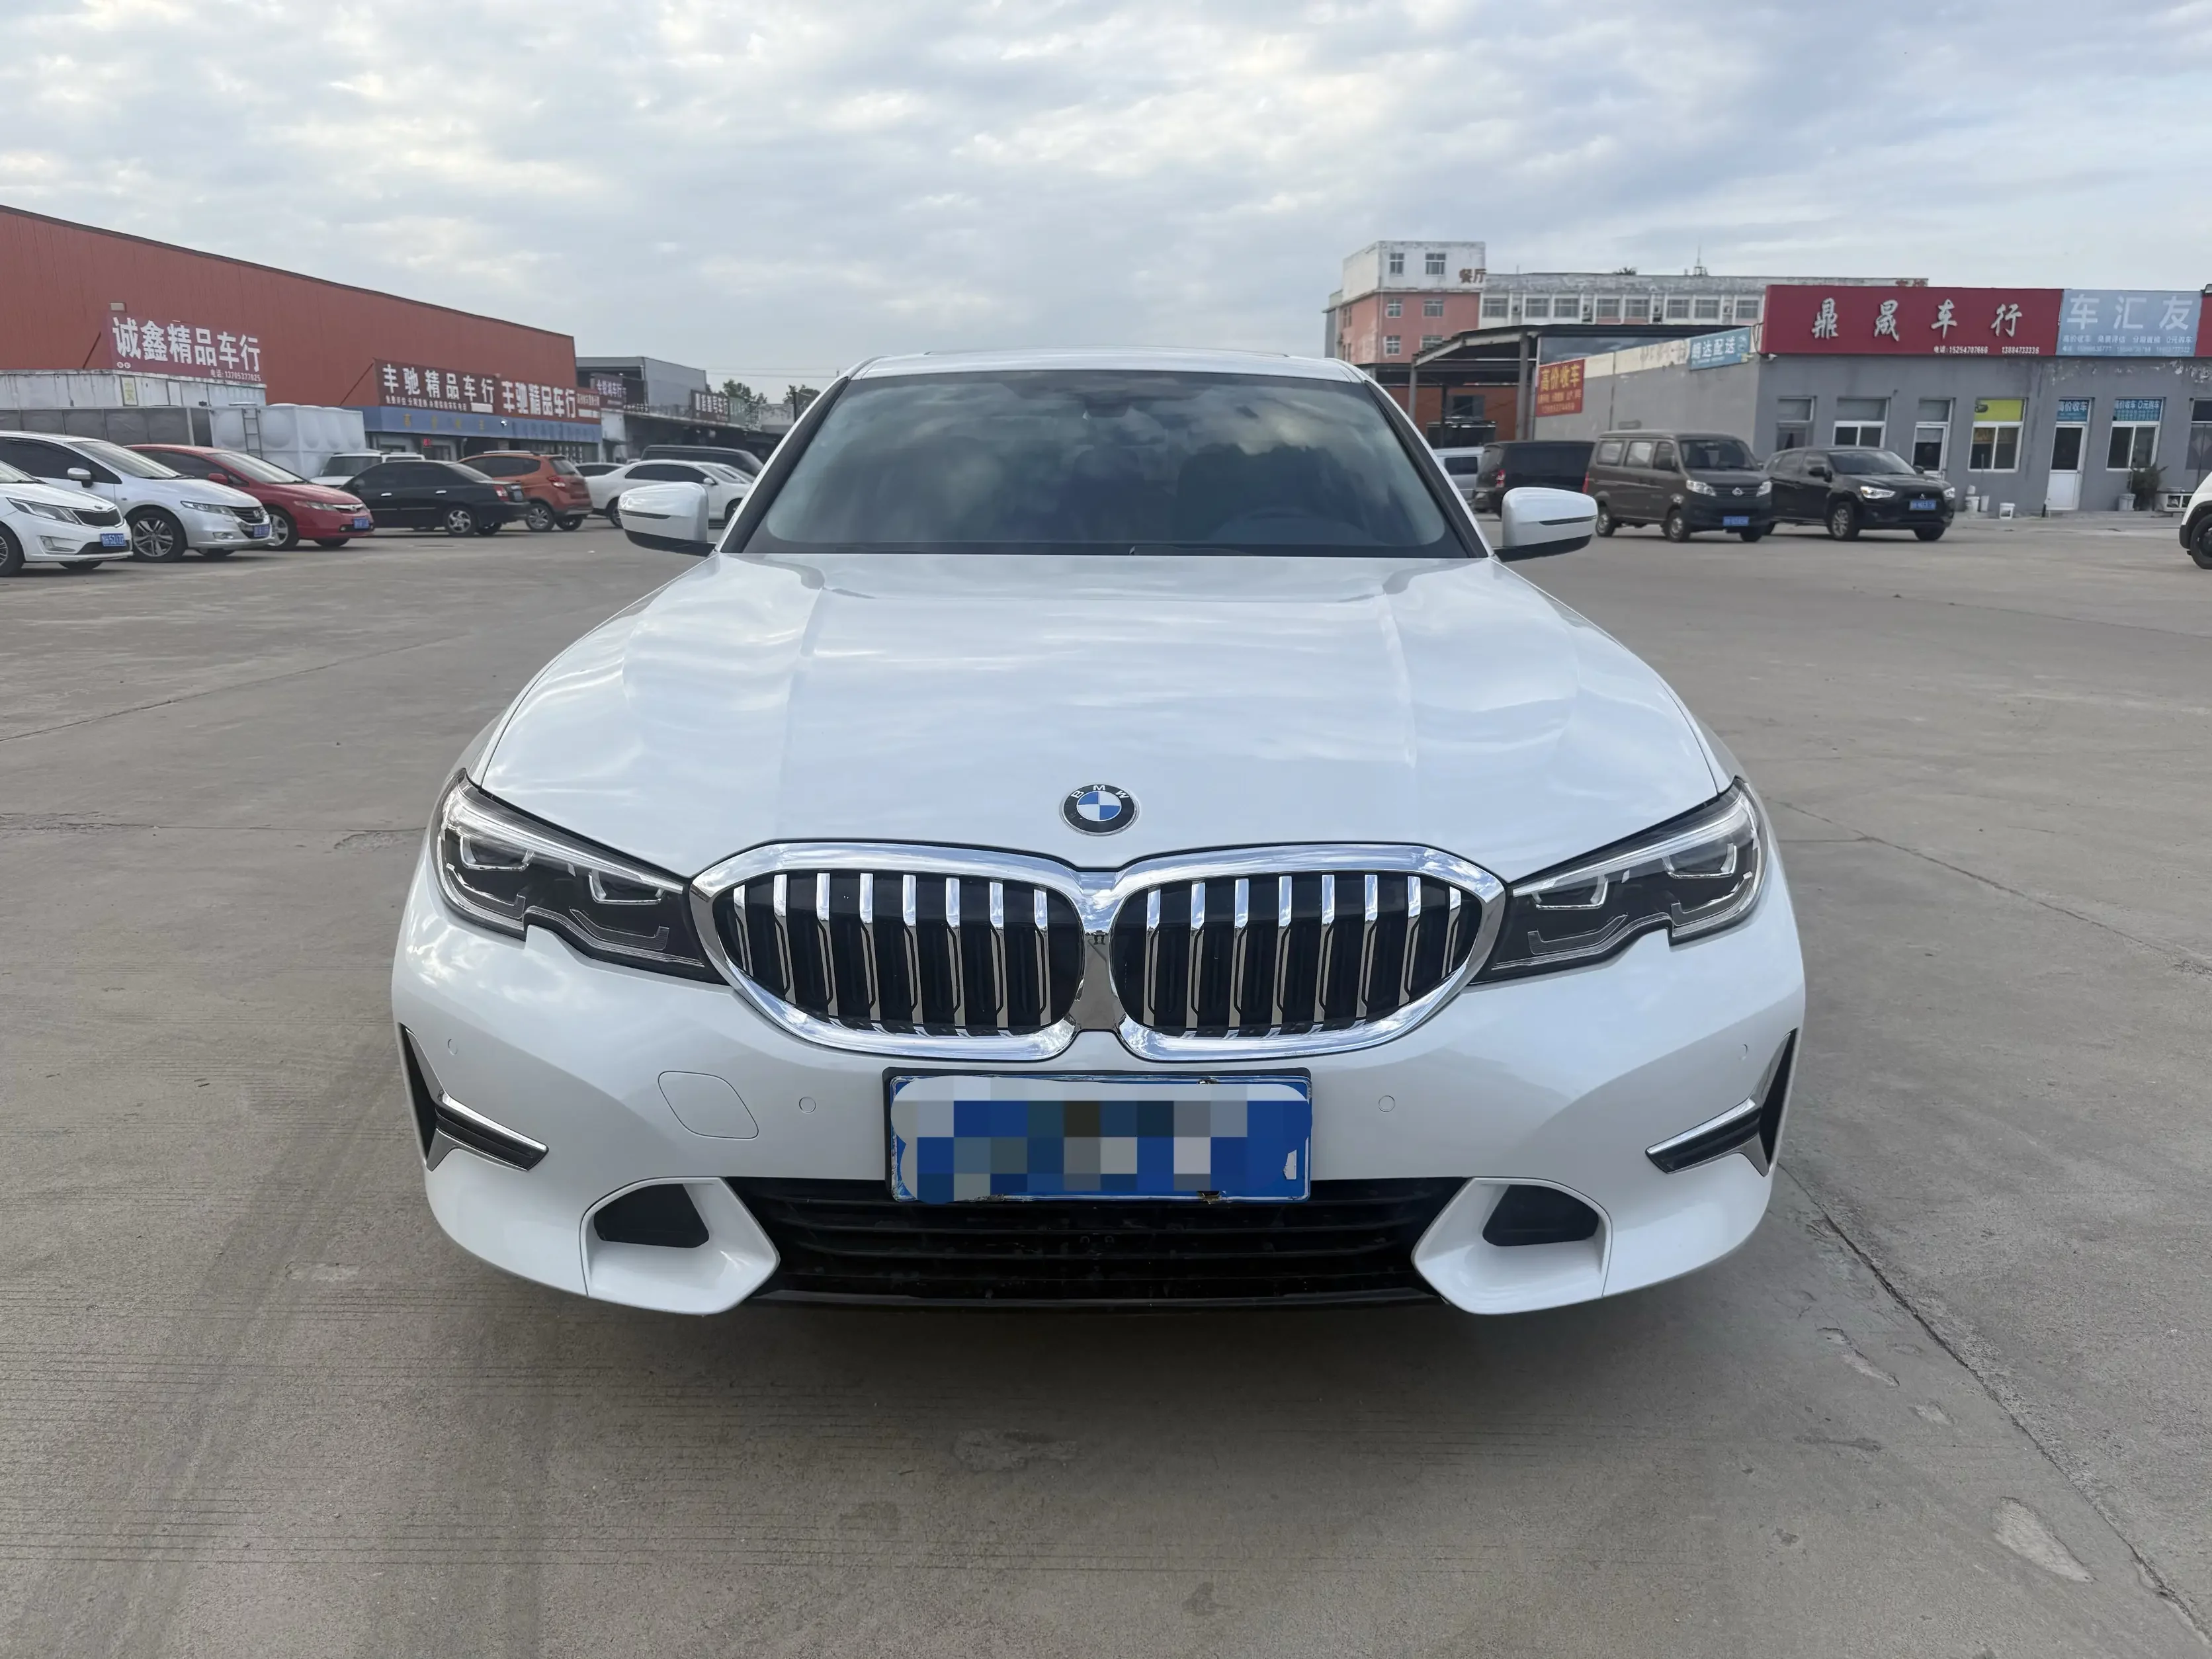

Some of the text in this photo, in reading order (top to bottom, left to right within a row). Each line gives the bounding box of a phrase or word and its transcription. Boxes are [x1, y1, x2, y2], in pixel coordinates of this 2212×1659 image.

[1459, 269, 1486, 284] 餐厅
[1811, 298, 2022, 341] 鼎晟车行
[2066, 294, 2193, 330] 车汇友
[112, 317, 261, 372] 诚鑫精品车行
[382, 364, 494, 404] 丰驰精品车行
[1540, 364, 1580, 392] 高价收车
[501, 381, 576, 418] 丰驰精品车行
[1070, 785, 1130, 799] BMW
